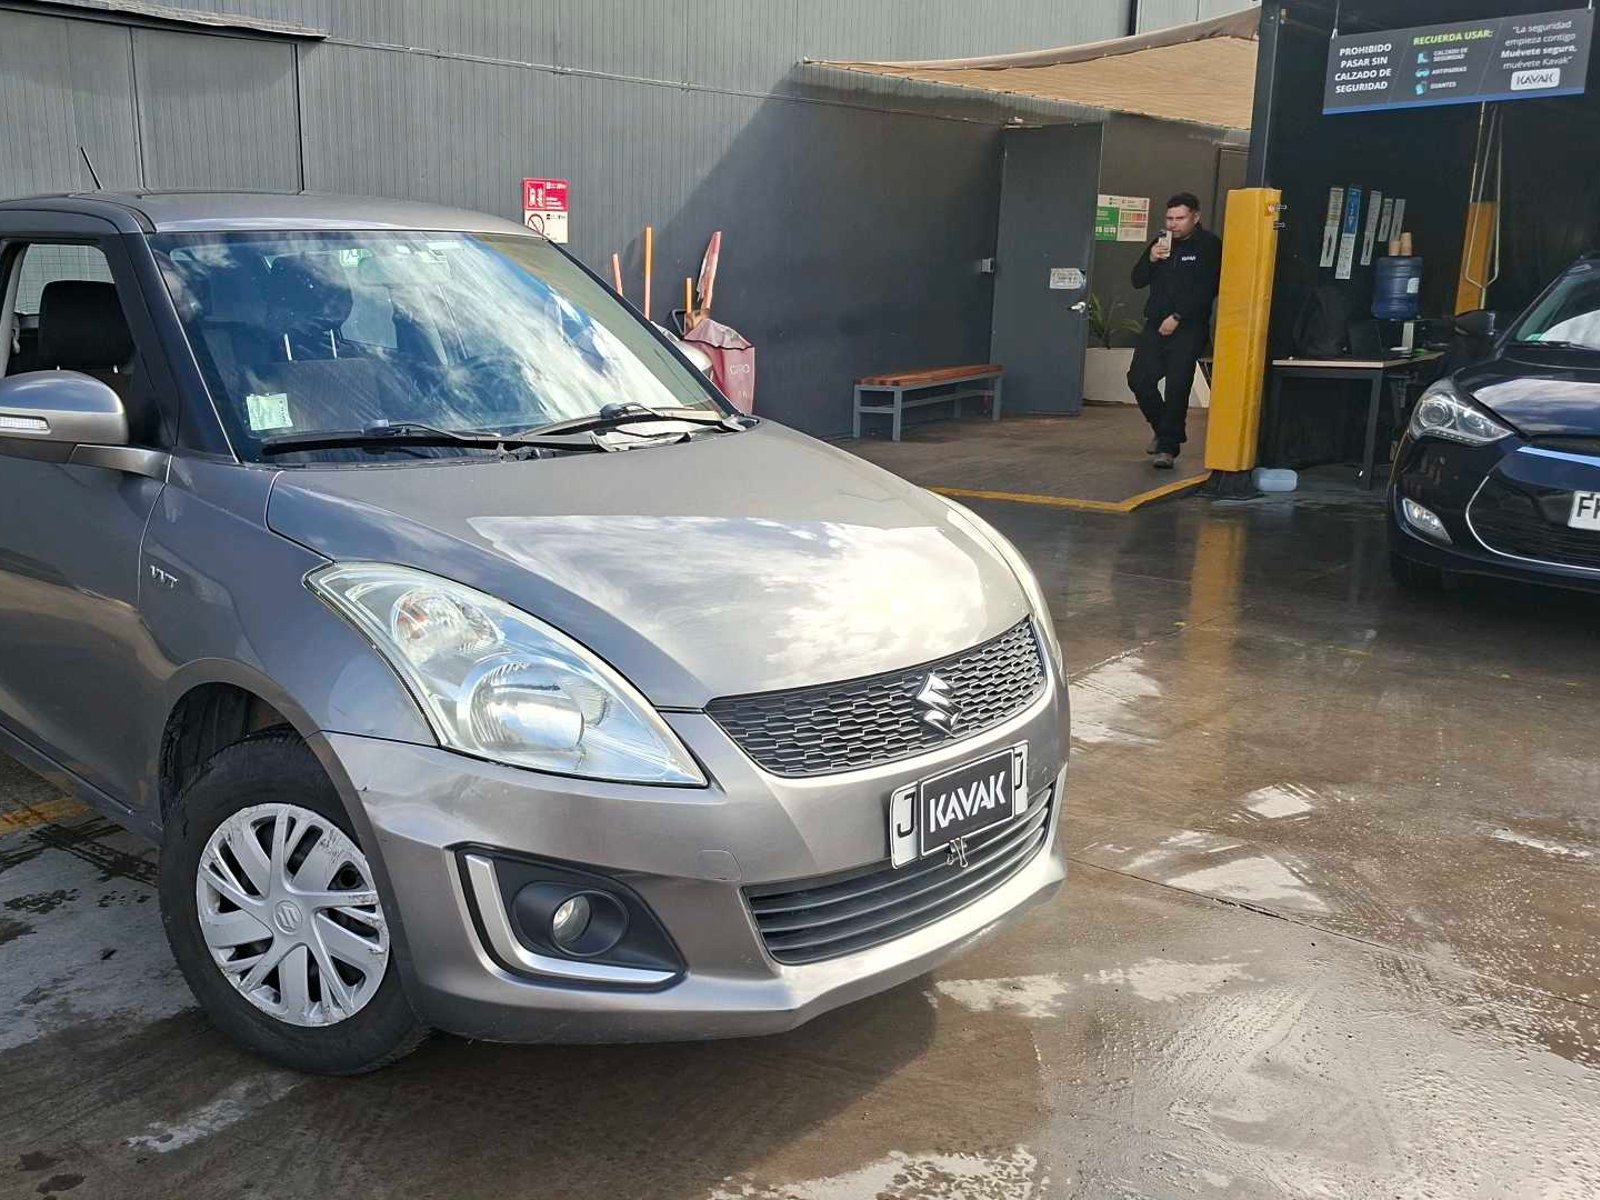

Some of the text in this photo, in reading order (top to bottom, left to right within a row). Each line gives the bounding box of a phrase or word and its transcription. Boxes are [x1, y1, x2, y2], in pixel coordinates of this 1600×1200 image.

[1528, 20, 1572, 34] seguridad
[1413, 29, 1494, 46] RECUERDA USAR:
[1505, 33, 1576, 47] empieza contigo
[1340, 43, 1392, 56] PROHIBIDO
[1341, 56, 1388, 68] PASAR SIN
[1335, 69, 1392, 81] CALZADO DE
[1516, 73, 1554, 85] KAVAK
[1335, 81, 1388, 94] SEGURIDAD
[929, 771, 1006, 833] KAVAK
